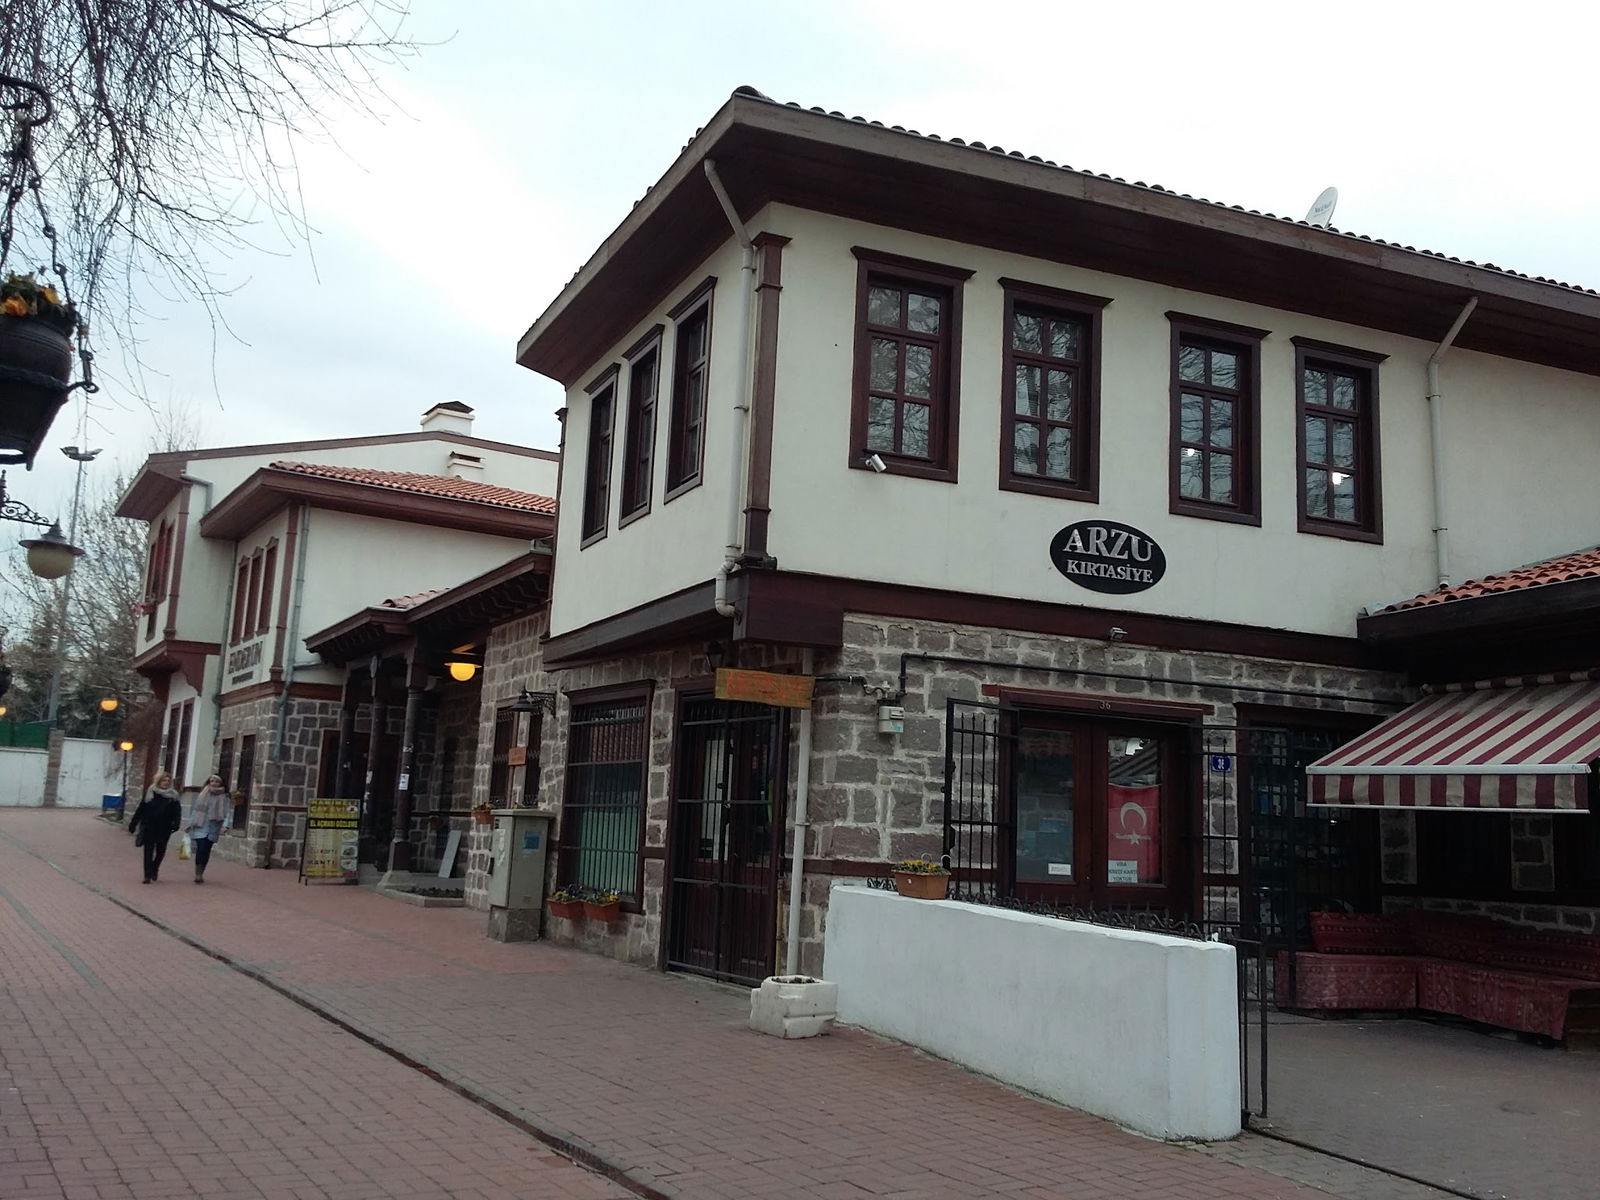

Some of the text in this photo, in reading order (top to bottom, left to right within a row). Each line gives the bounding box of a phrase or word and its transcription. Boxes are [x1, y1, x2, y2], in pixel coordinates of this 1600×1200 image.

[1062, 526, 1154, 562] ARZU
[1066, 559, 1154, 584] KIRTASİYE
[1099, 701, 1111, 710] 36
